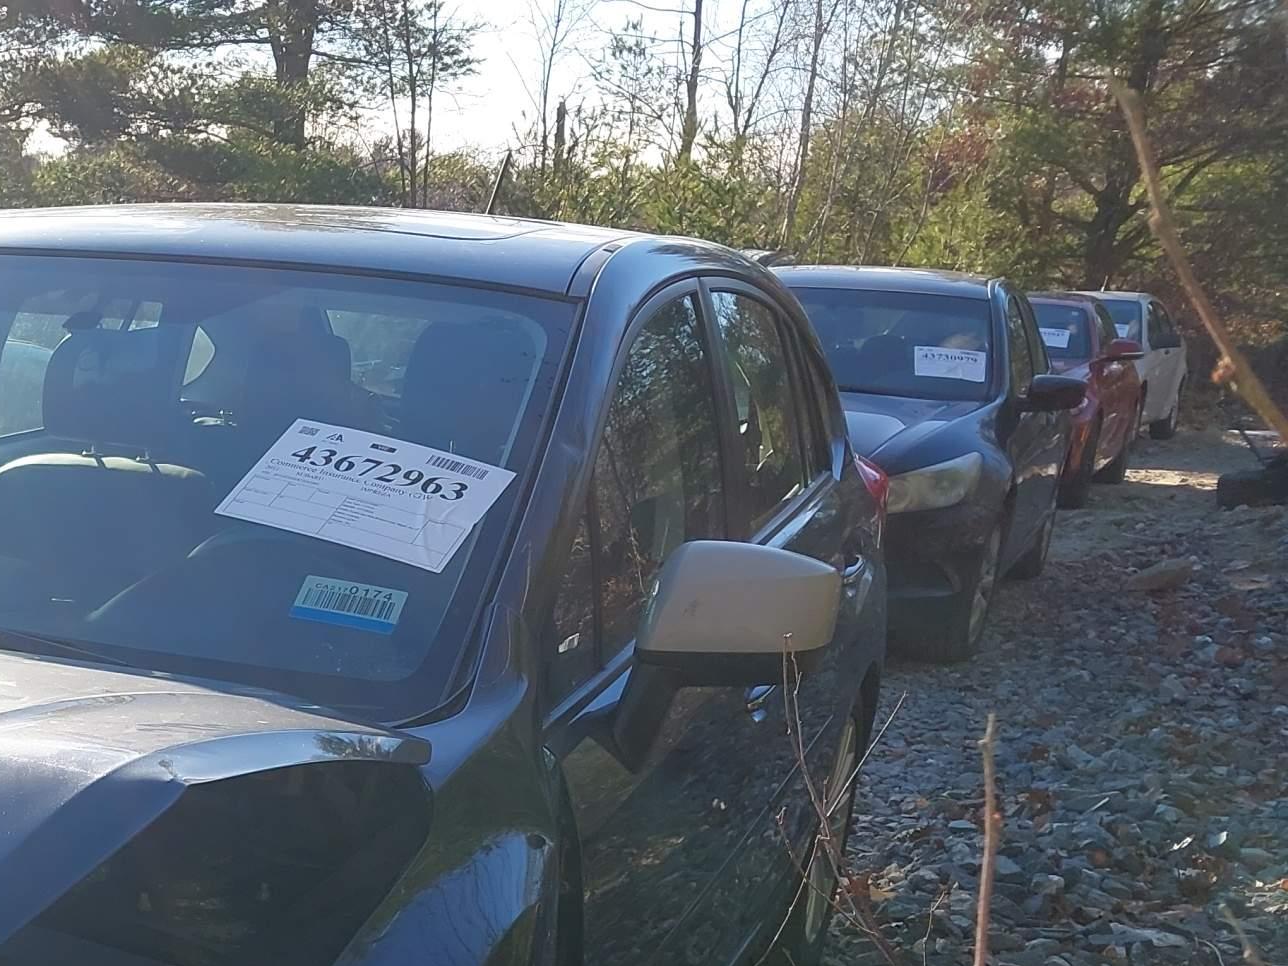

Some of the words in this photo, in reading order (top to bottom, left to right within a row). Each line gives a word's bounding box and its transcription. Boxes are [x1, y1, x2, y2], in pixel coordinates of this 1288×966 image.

[270, 458, 318, 474] Commerce
[363, 479, 405, 496] Company
[291, 446, 469, 501] 43672963
